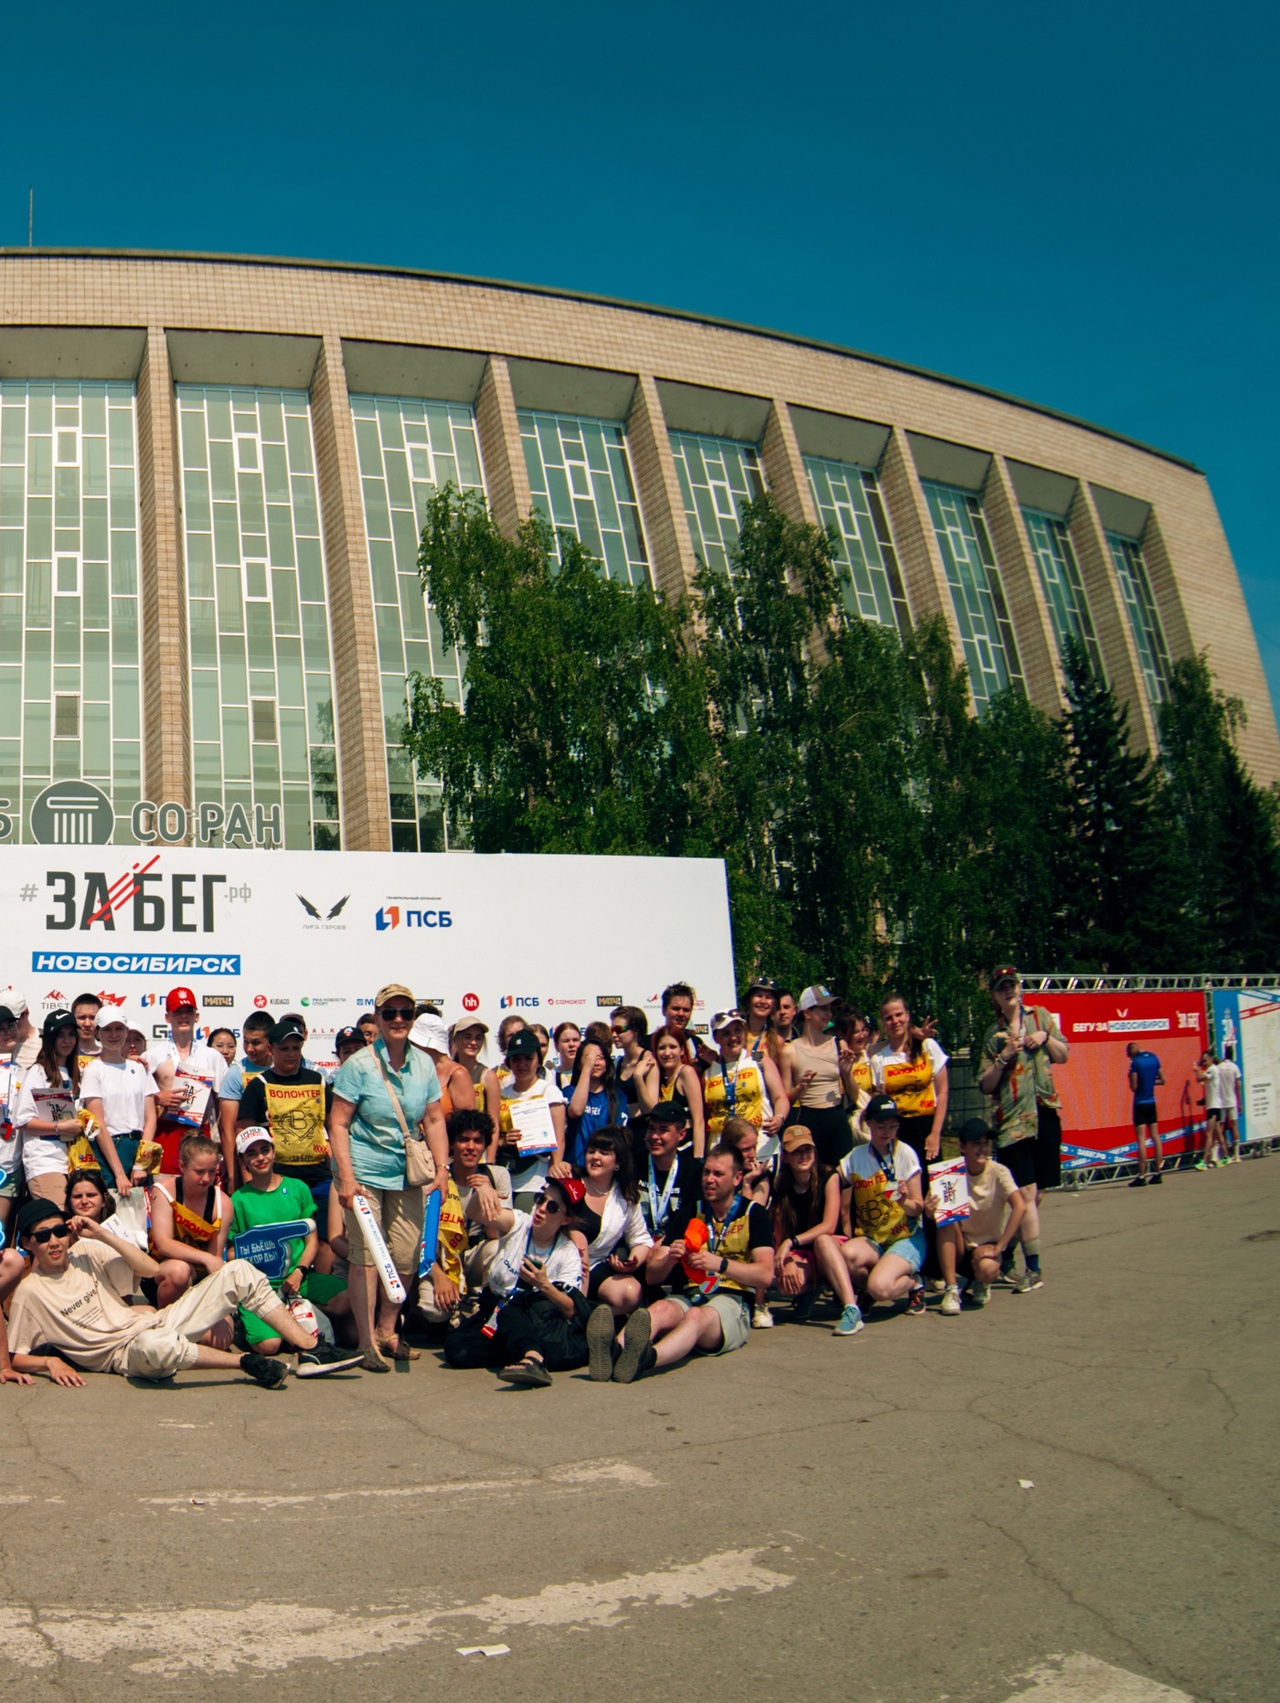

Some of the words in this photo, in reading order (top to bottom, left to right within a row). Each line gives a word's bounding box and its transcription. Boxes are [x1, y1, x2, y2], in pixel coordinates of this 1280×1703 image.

[131, 800, 187, 844] СО
[198, 802, 283, 846] РАН
[406, 910, 453, 928] ПСБ
[36, 955, 236, 974] НОВОСИБИРСК
[516, 997, 540, 1007] ПСБ
[1072, 1022, 1095, 1032] БЕГУ
[1096, 1021, 1108, 1031] ЗА
[1109, 1019, 1168, 1031] НОВОСИБИРСК
[269, 1089, 321, 1099] ВОЛОНТЕР
[240, 1246, 250, 1256] ТЫ
[251, 1239, 276, 1254] БЬЁШЬ
[60, 1299, 83, 1317] Never
[83, 1288, 99, 1304] give
